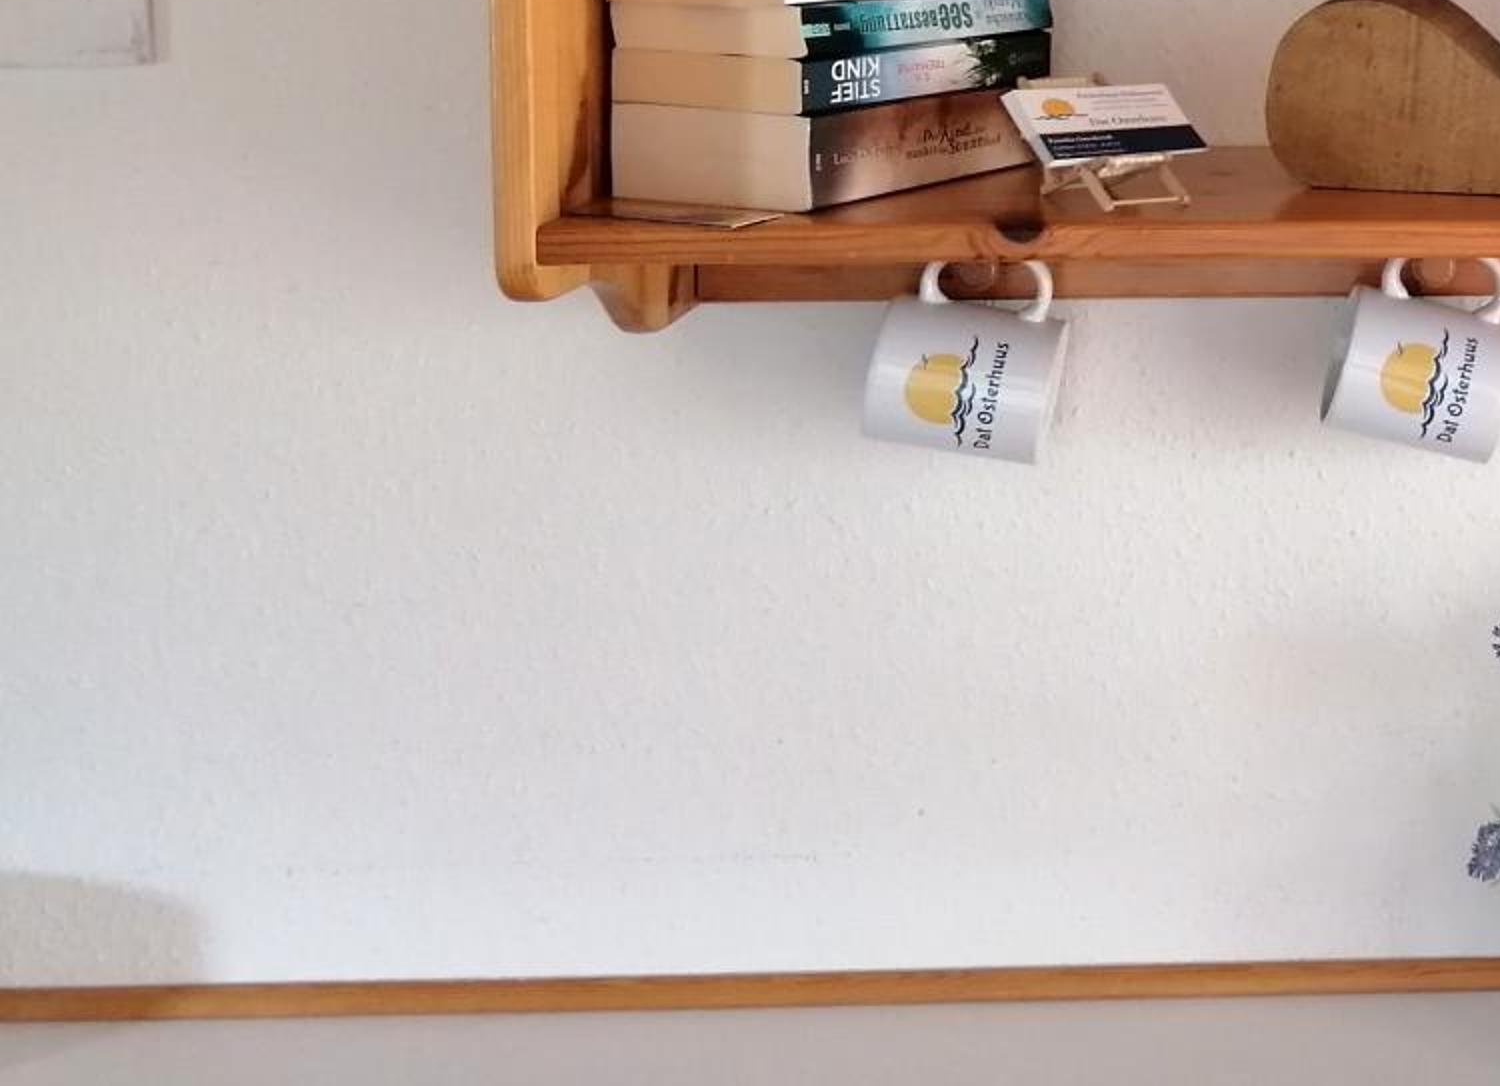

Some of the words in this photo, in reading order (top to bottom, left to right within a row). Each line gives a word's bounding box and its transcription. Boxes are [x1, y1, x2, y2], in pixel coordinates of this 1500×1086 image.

[830, 57, 881, 81] KIND
[830, 78, 881, 103] STIEF
[977, 341, 1009, 425] Osterhuus
[1447, 337, 1479, 417] Osterhuus
[973, 427, 993, 450] Dat
[1436, 419, 1459, 443] Dat
